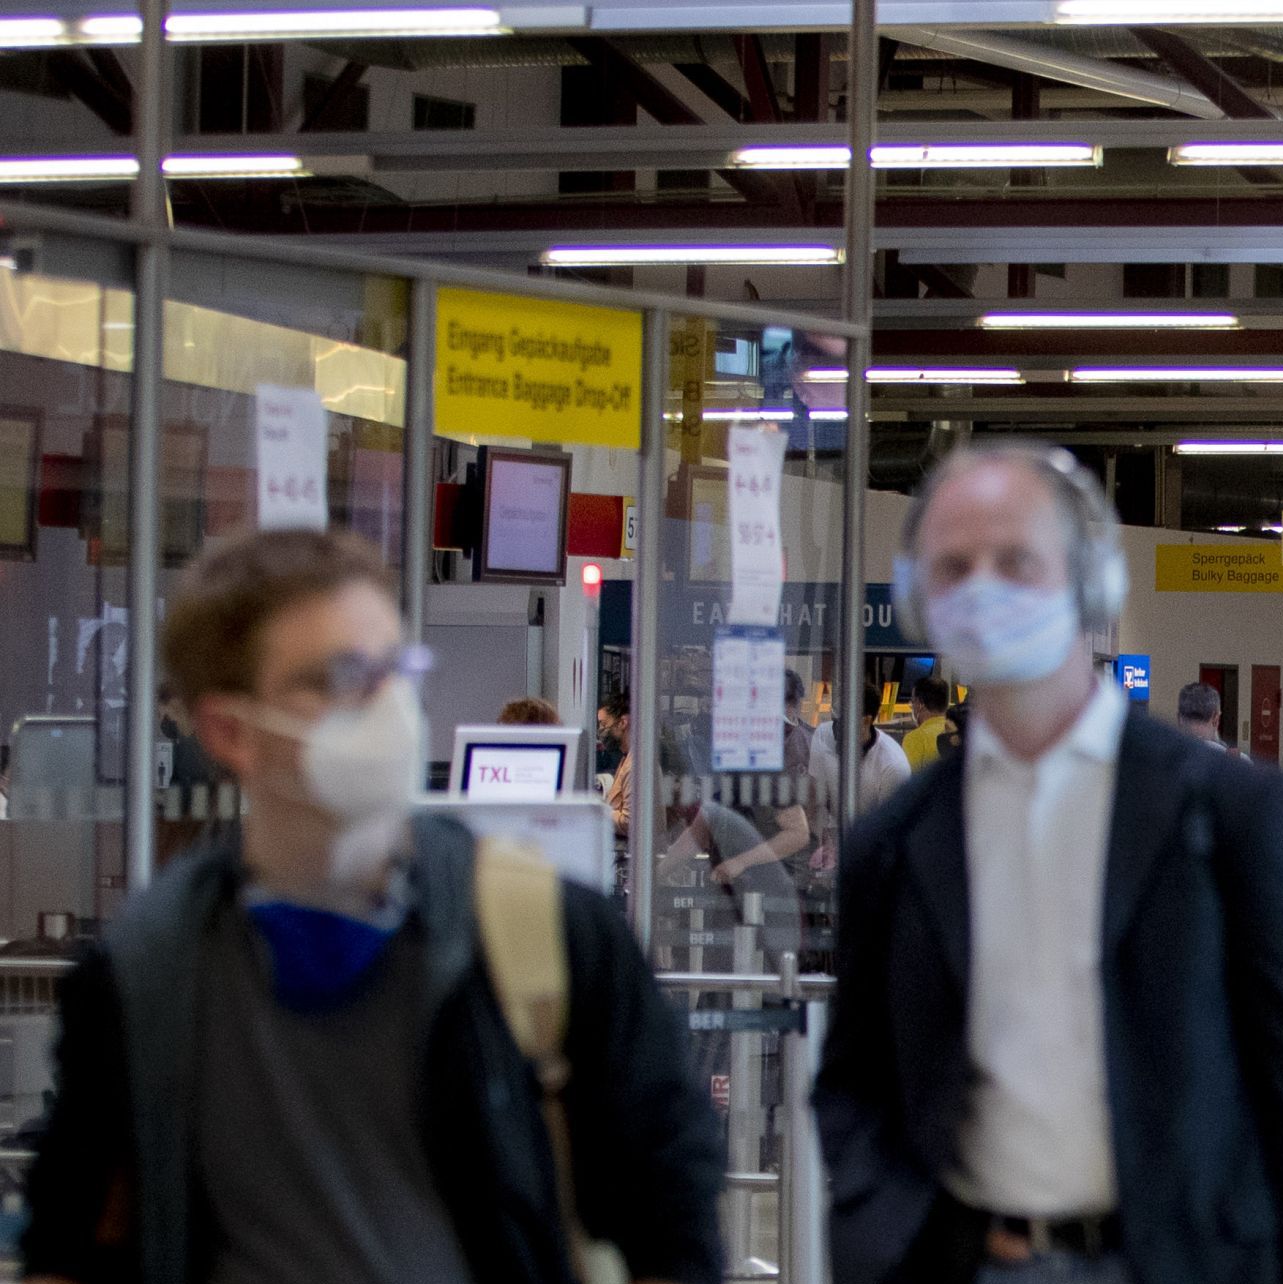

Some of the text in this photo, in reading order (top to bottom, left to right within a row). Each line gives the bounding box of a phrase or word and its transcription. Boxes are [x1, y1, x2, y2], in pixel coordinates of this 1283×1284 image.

[1192, 553, 1265, 567] Sperrgepäck
[1192, 570, 1279, 584] Bulky Baggage
[693, 601, 730, 625] EA
[779, 603, 827, 626] HAT
[478, 766, 512, 783] TXL
